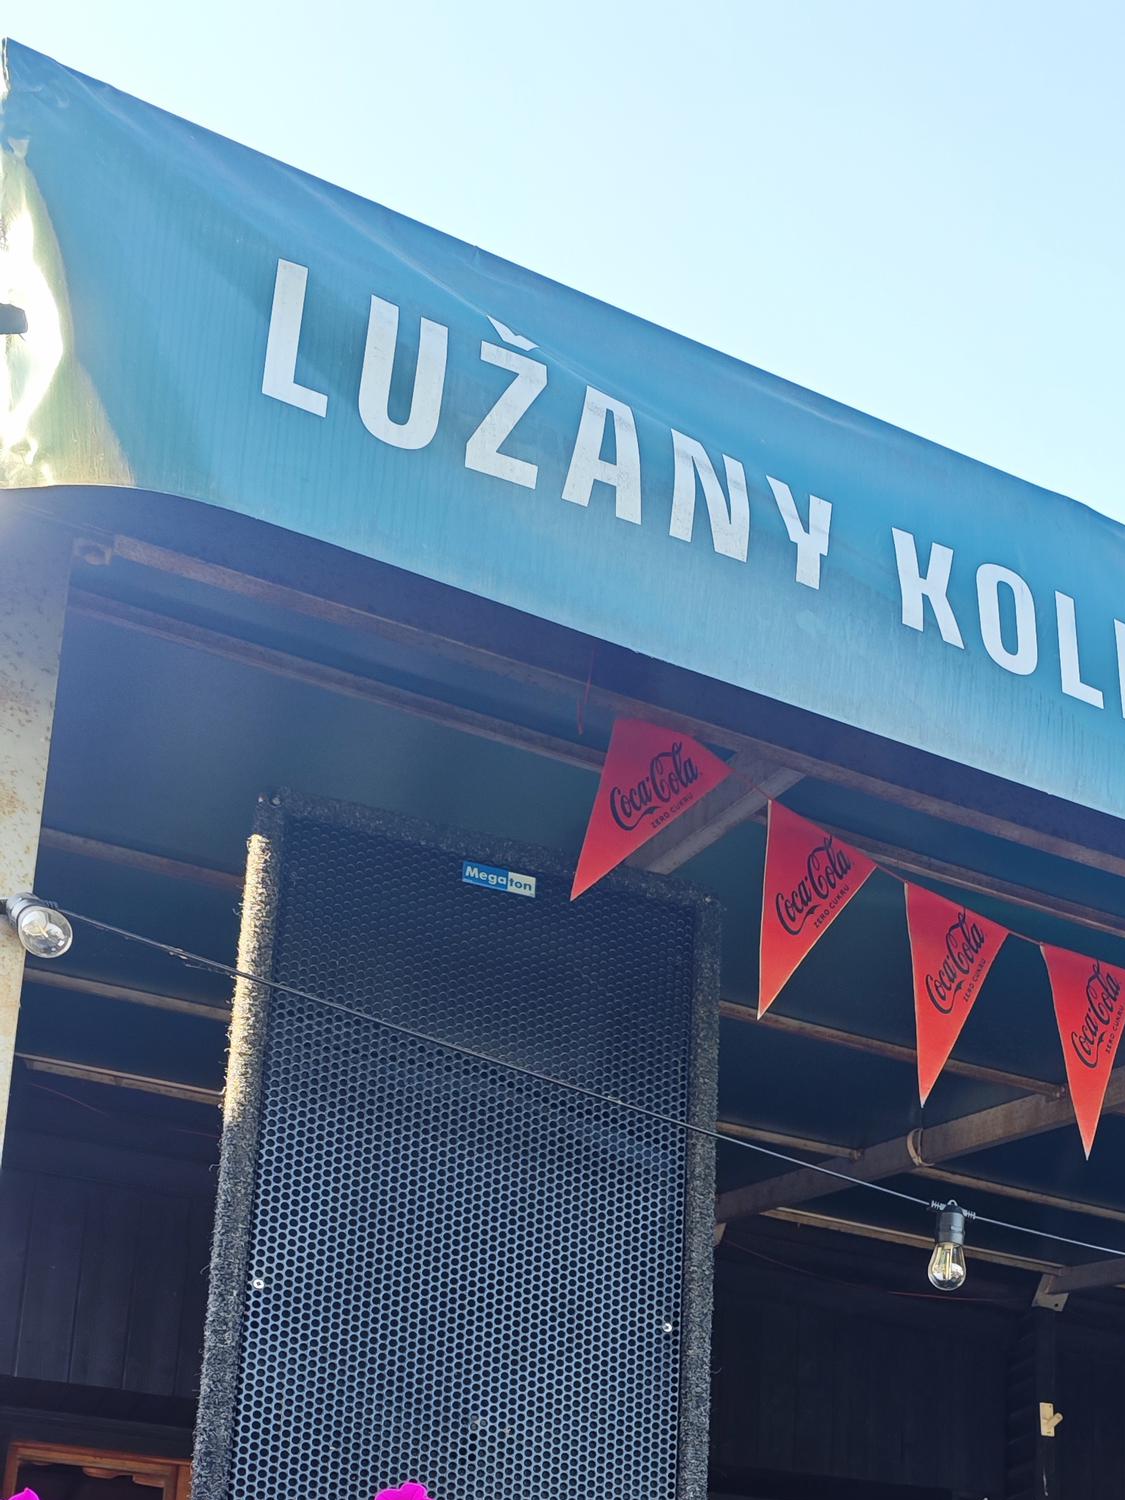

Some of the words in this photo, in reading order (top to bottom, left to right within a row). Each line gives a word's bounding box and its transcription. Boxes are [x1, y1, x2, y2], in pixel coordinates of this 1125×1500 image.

[261, 258, 832, 590] LUŽANY
[610, 741, 699, 831] Coca-Cola
[651, 812, 670, 828] ZERO
[465, 866, 532, 891] Megaton
[776, 834, 852, 935] Coca-Cola
[814, 909, 830, 928] ZERO
[925, 907, 985, 1014] Coca-Cola
[1071, 960, 1120, 1068] Coca-Cola
